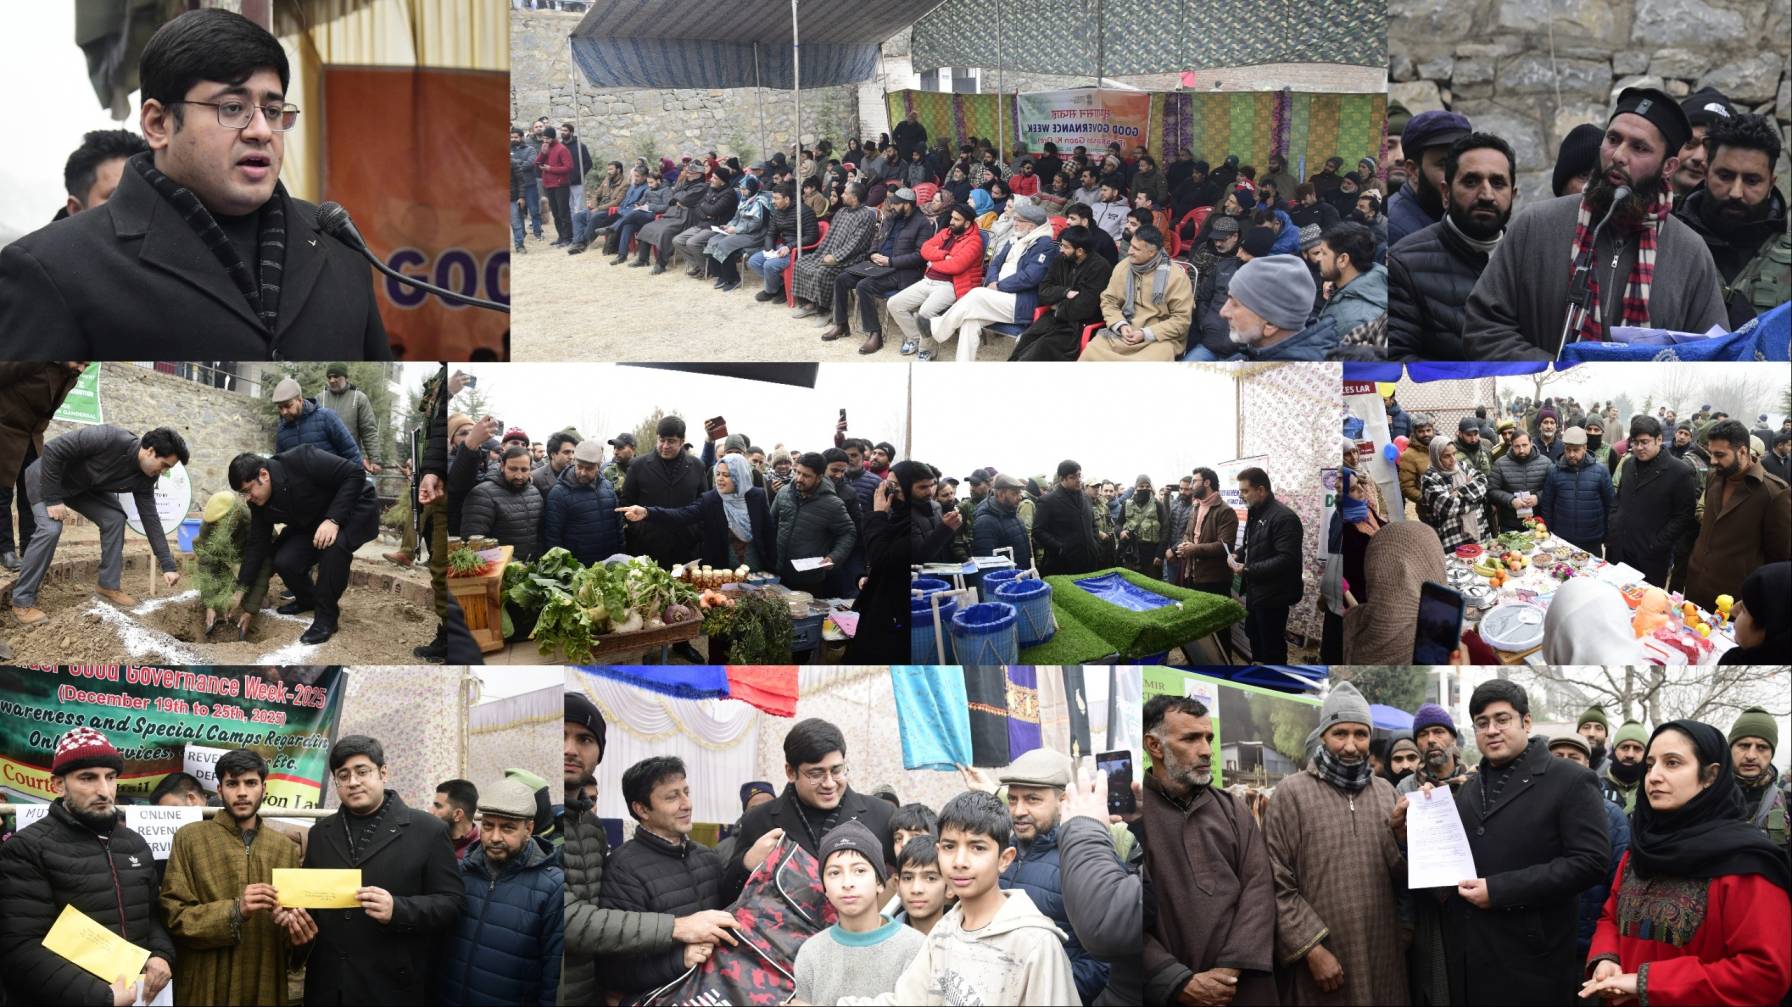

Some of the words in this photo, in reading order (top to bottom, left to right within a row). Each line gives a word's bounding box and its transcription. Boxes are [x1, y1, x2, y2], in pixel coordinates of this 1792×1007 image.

[384, 248, 510, 308] GOO
[1355, 384, 1371, 393] LAR
[125, 664, 240, 697] Governance
[244, 674, 327, 709] Week-2025
[1143, 679, 1165, 690] MIR
[58, 684, 150, 710] (December
[154, 696, 189, 715] 19th
[193, 701, 209, 716] to
[212, 703, 248, 722] 25th,
[251, 708, 287, 728] 2025)
[0, 700, 86, 727] wareness
[89, 714, 131, 732] and
[132, 715, 202, 739] Special
[206, 724, 261, 747] Camps
[264, 730, 329, 750] Regardin
[29, 730, 59, 750] Onl
[187, 751, 220, 764] REVE
[196, 769, 217, 781] DEP
[3, 763, 58, 794] Courte
[262, 792, 289, 809] ion
[25, 807, 49, 818] MU
[140, 810, 182, 820] ONLINE
[147, 842, 171, 852] RVI
